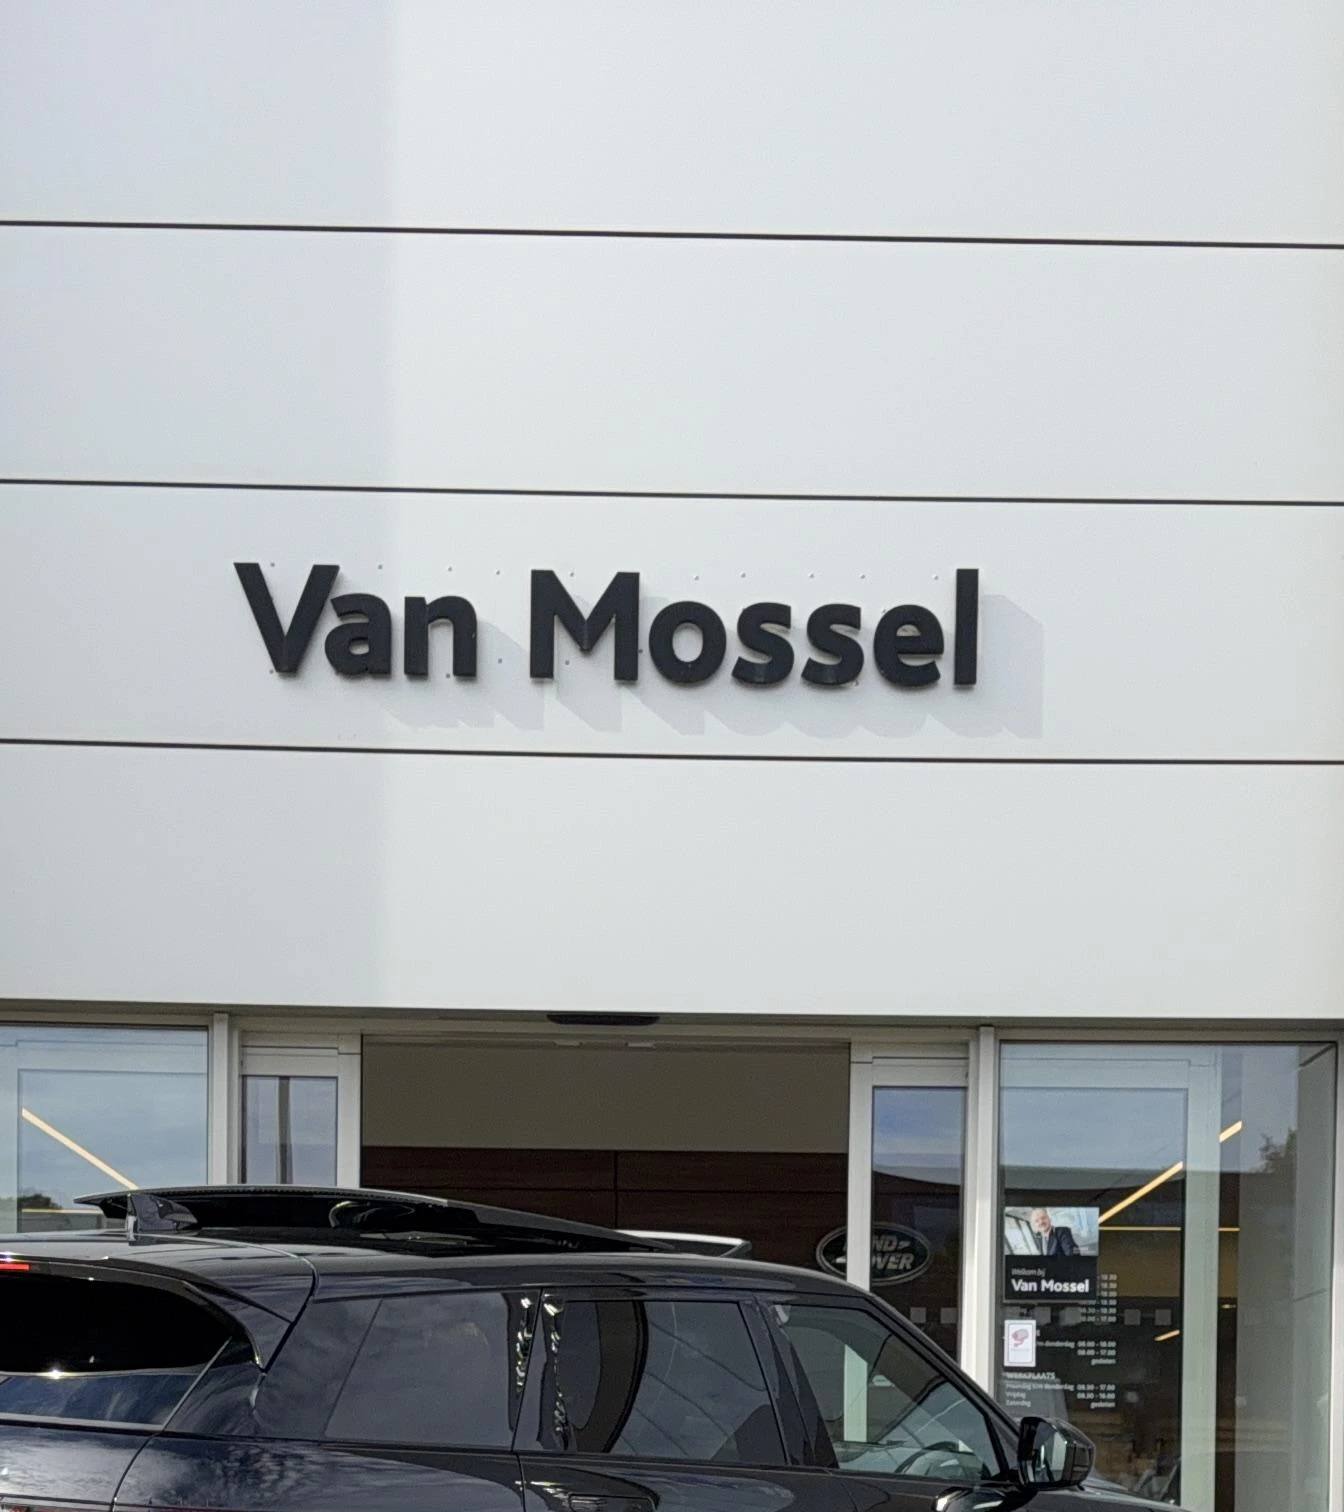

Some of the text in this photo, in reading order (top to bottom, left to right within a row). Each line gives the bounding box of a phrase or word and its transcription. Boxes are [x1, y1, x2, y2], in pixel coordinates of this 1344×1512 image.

[233, 562, 980, 687] Van Mossel
[1011, 1279, 1038, 1292] Van
[1041, 1279, 1090, 1293] Mossel
